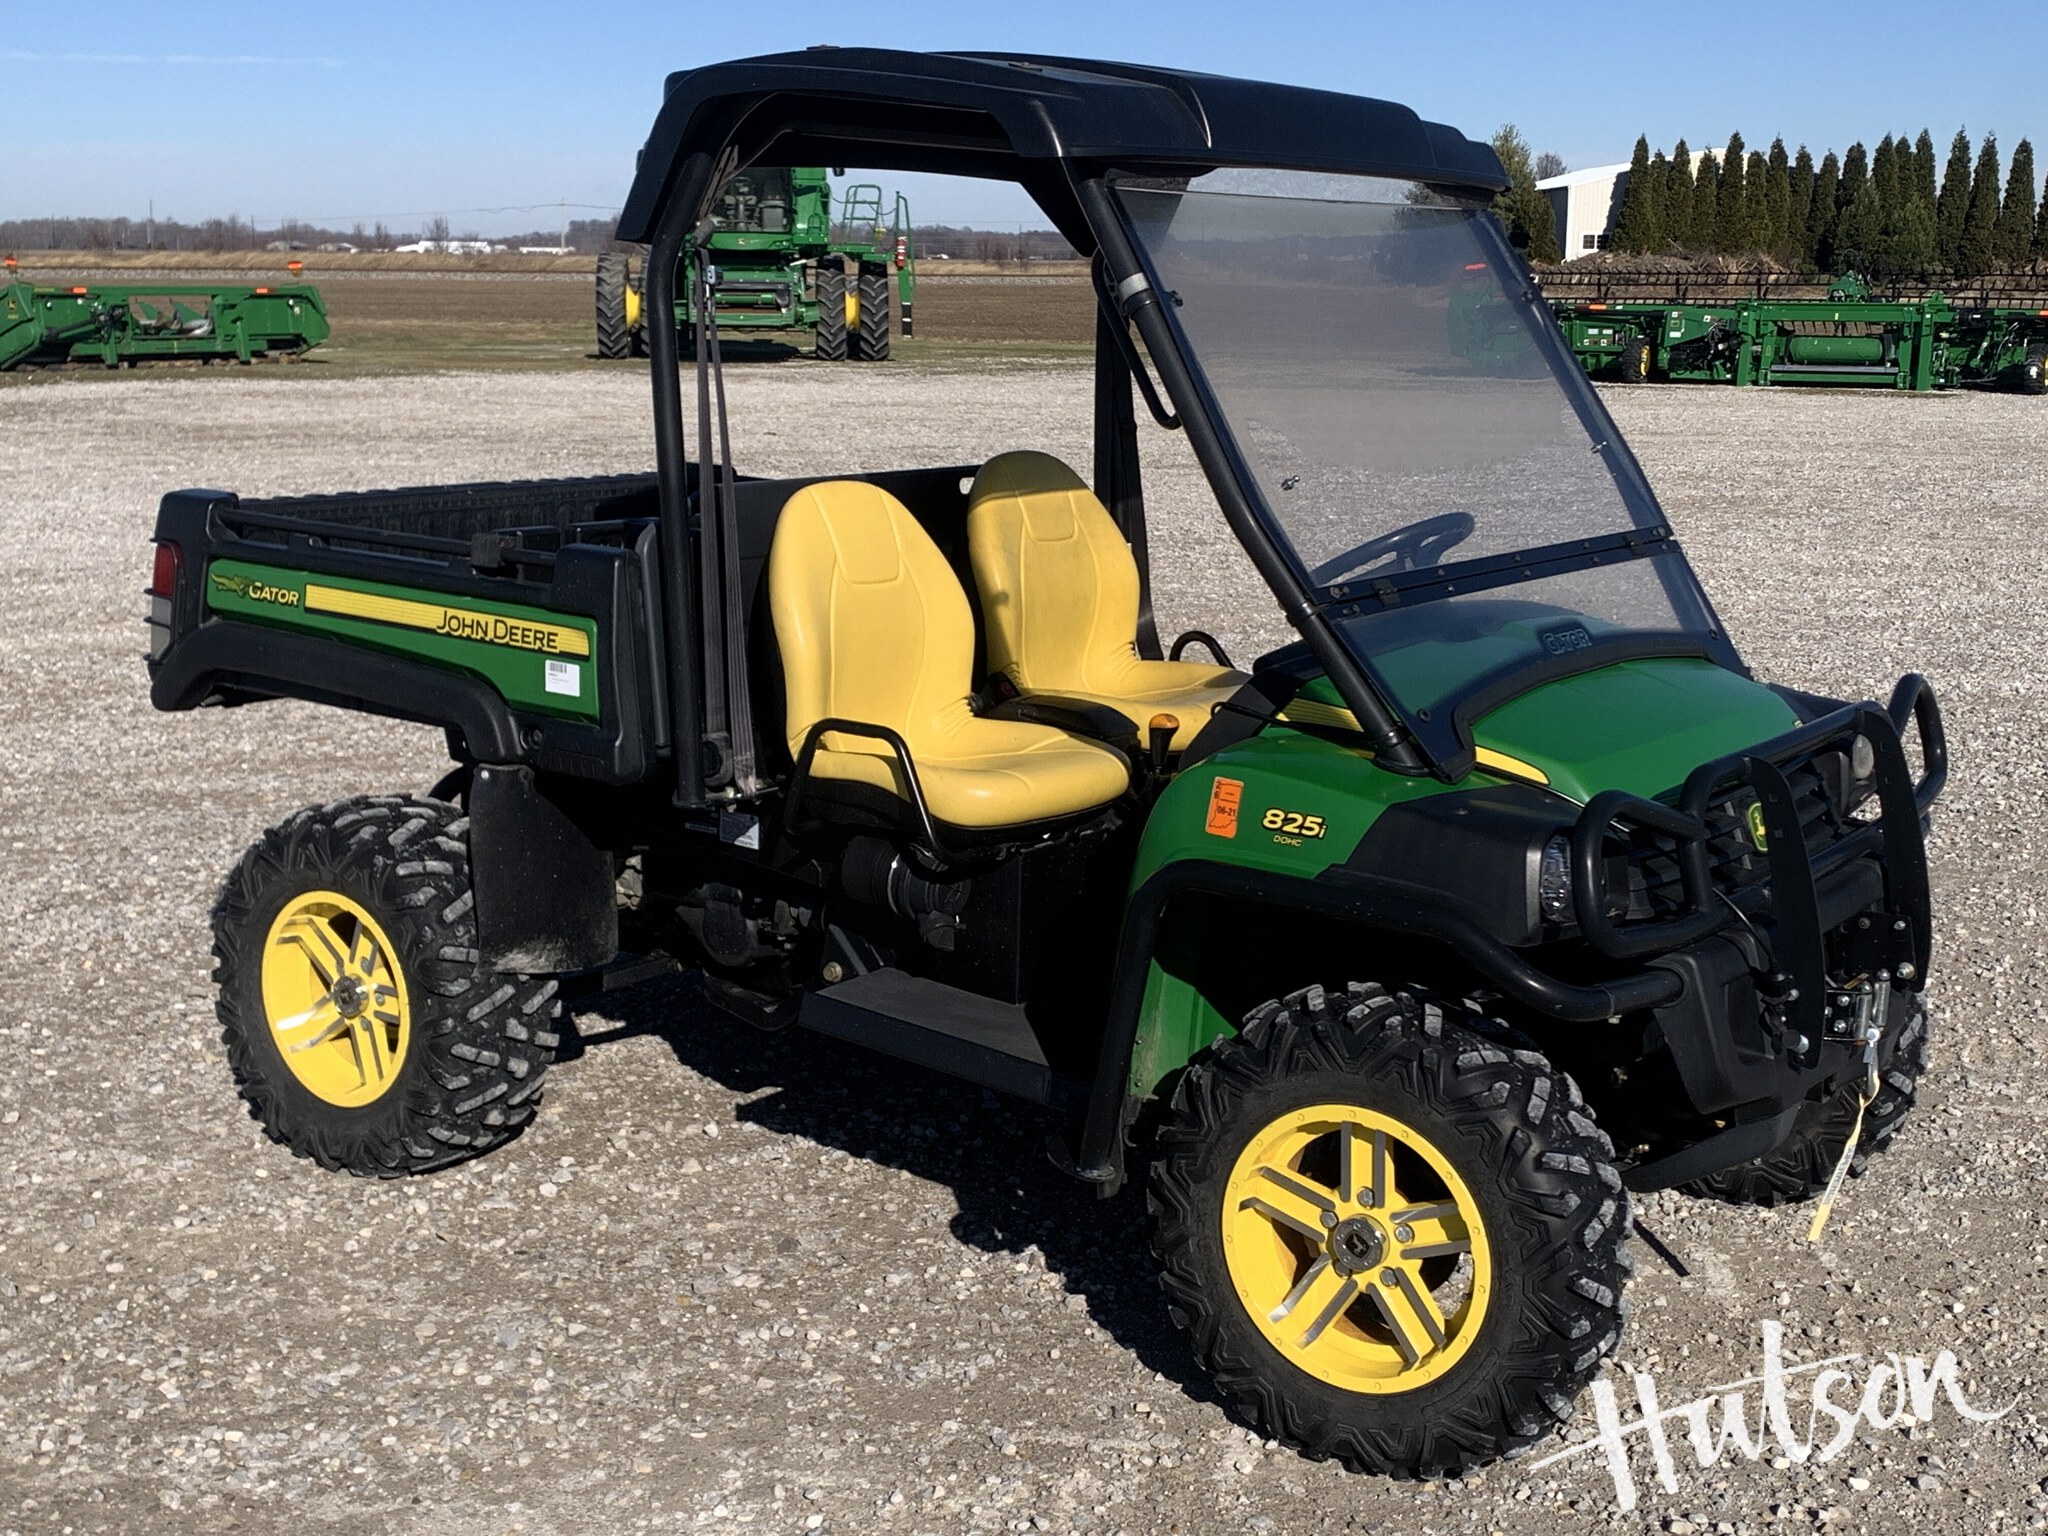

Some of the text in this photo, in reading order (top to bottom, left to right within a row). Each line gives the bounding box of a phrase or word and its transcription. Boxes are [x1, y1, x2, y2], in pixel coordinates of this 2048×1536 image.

[249, 581, 299, 606] GATOR
[436, 610, 559, 650] JOHN DEERE
[1543, 629, 1592, 655] GATOR
[1262, 808, 1327, 839] 825i
[1273, 834, 1302, 847] DOHC
